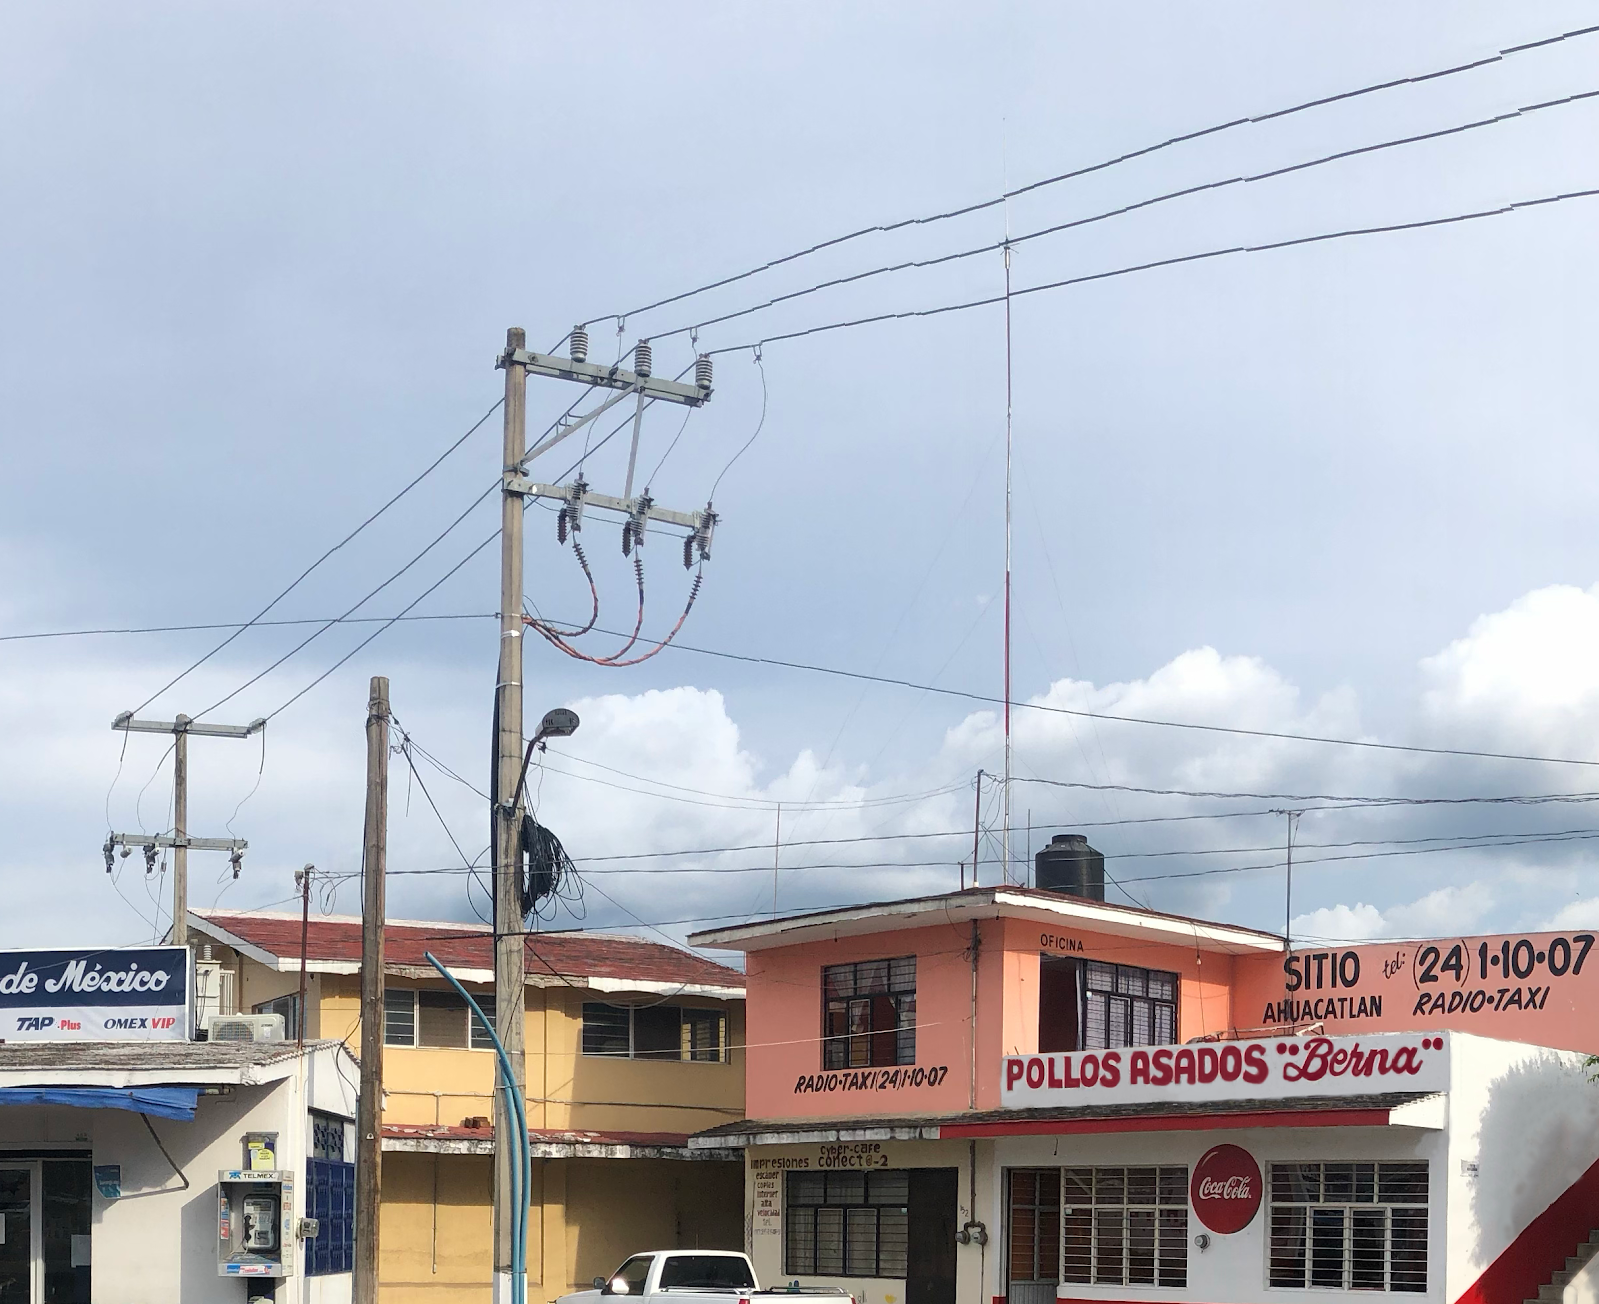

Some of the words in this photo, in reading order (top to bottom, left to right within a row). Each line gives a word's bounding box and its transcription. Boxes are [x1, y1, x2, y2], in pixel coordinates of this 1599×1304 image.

[1039, 933, 1084, 952] OFICINA
[0, 960, 37, 994] de
[44, 959, 172, 995] México
[1283, 950, 1361, 992] SITIO
[1412, 939, 1471, 991] (24)
[1263, 995, 1383, 1024] AHUACATLAN
[16, 1016, 54, 1031] TAP
[60, 1018, 82, 1031] Plus
[103, 1018, 148, 1030] OMEX
[151, 1017, 176, 1029] VIP
[1006, 1051, 1121, 1092] POLLOS
[1130, 1044, 1269, 1086] ASADOS
[1276, 1036, 1444, 1083] "Berna"
[1199, 1176, 1252, 1200] Coca-Cola
